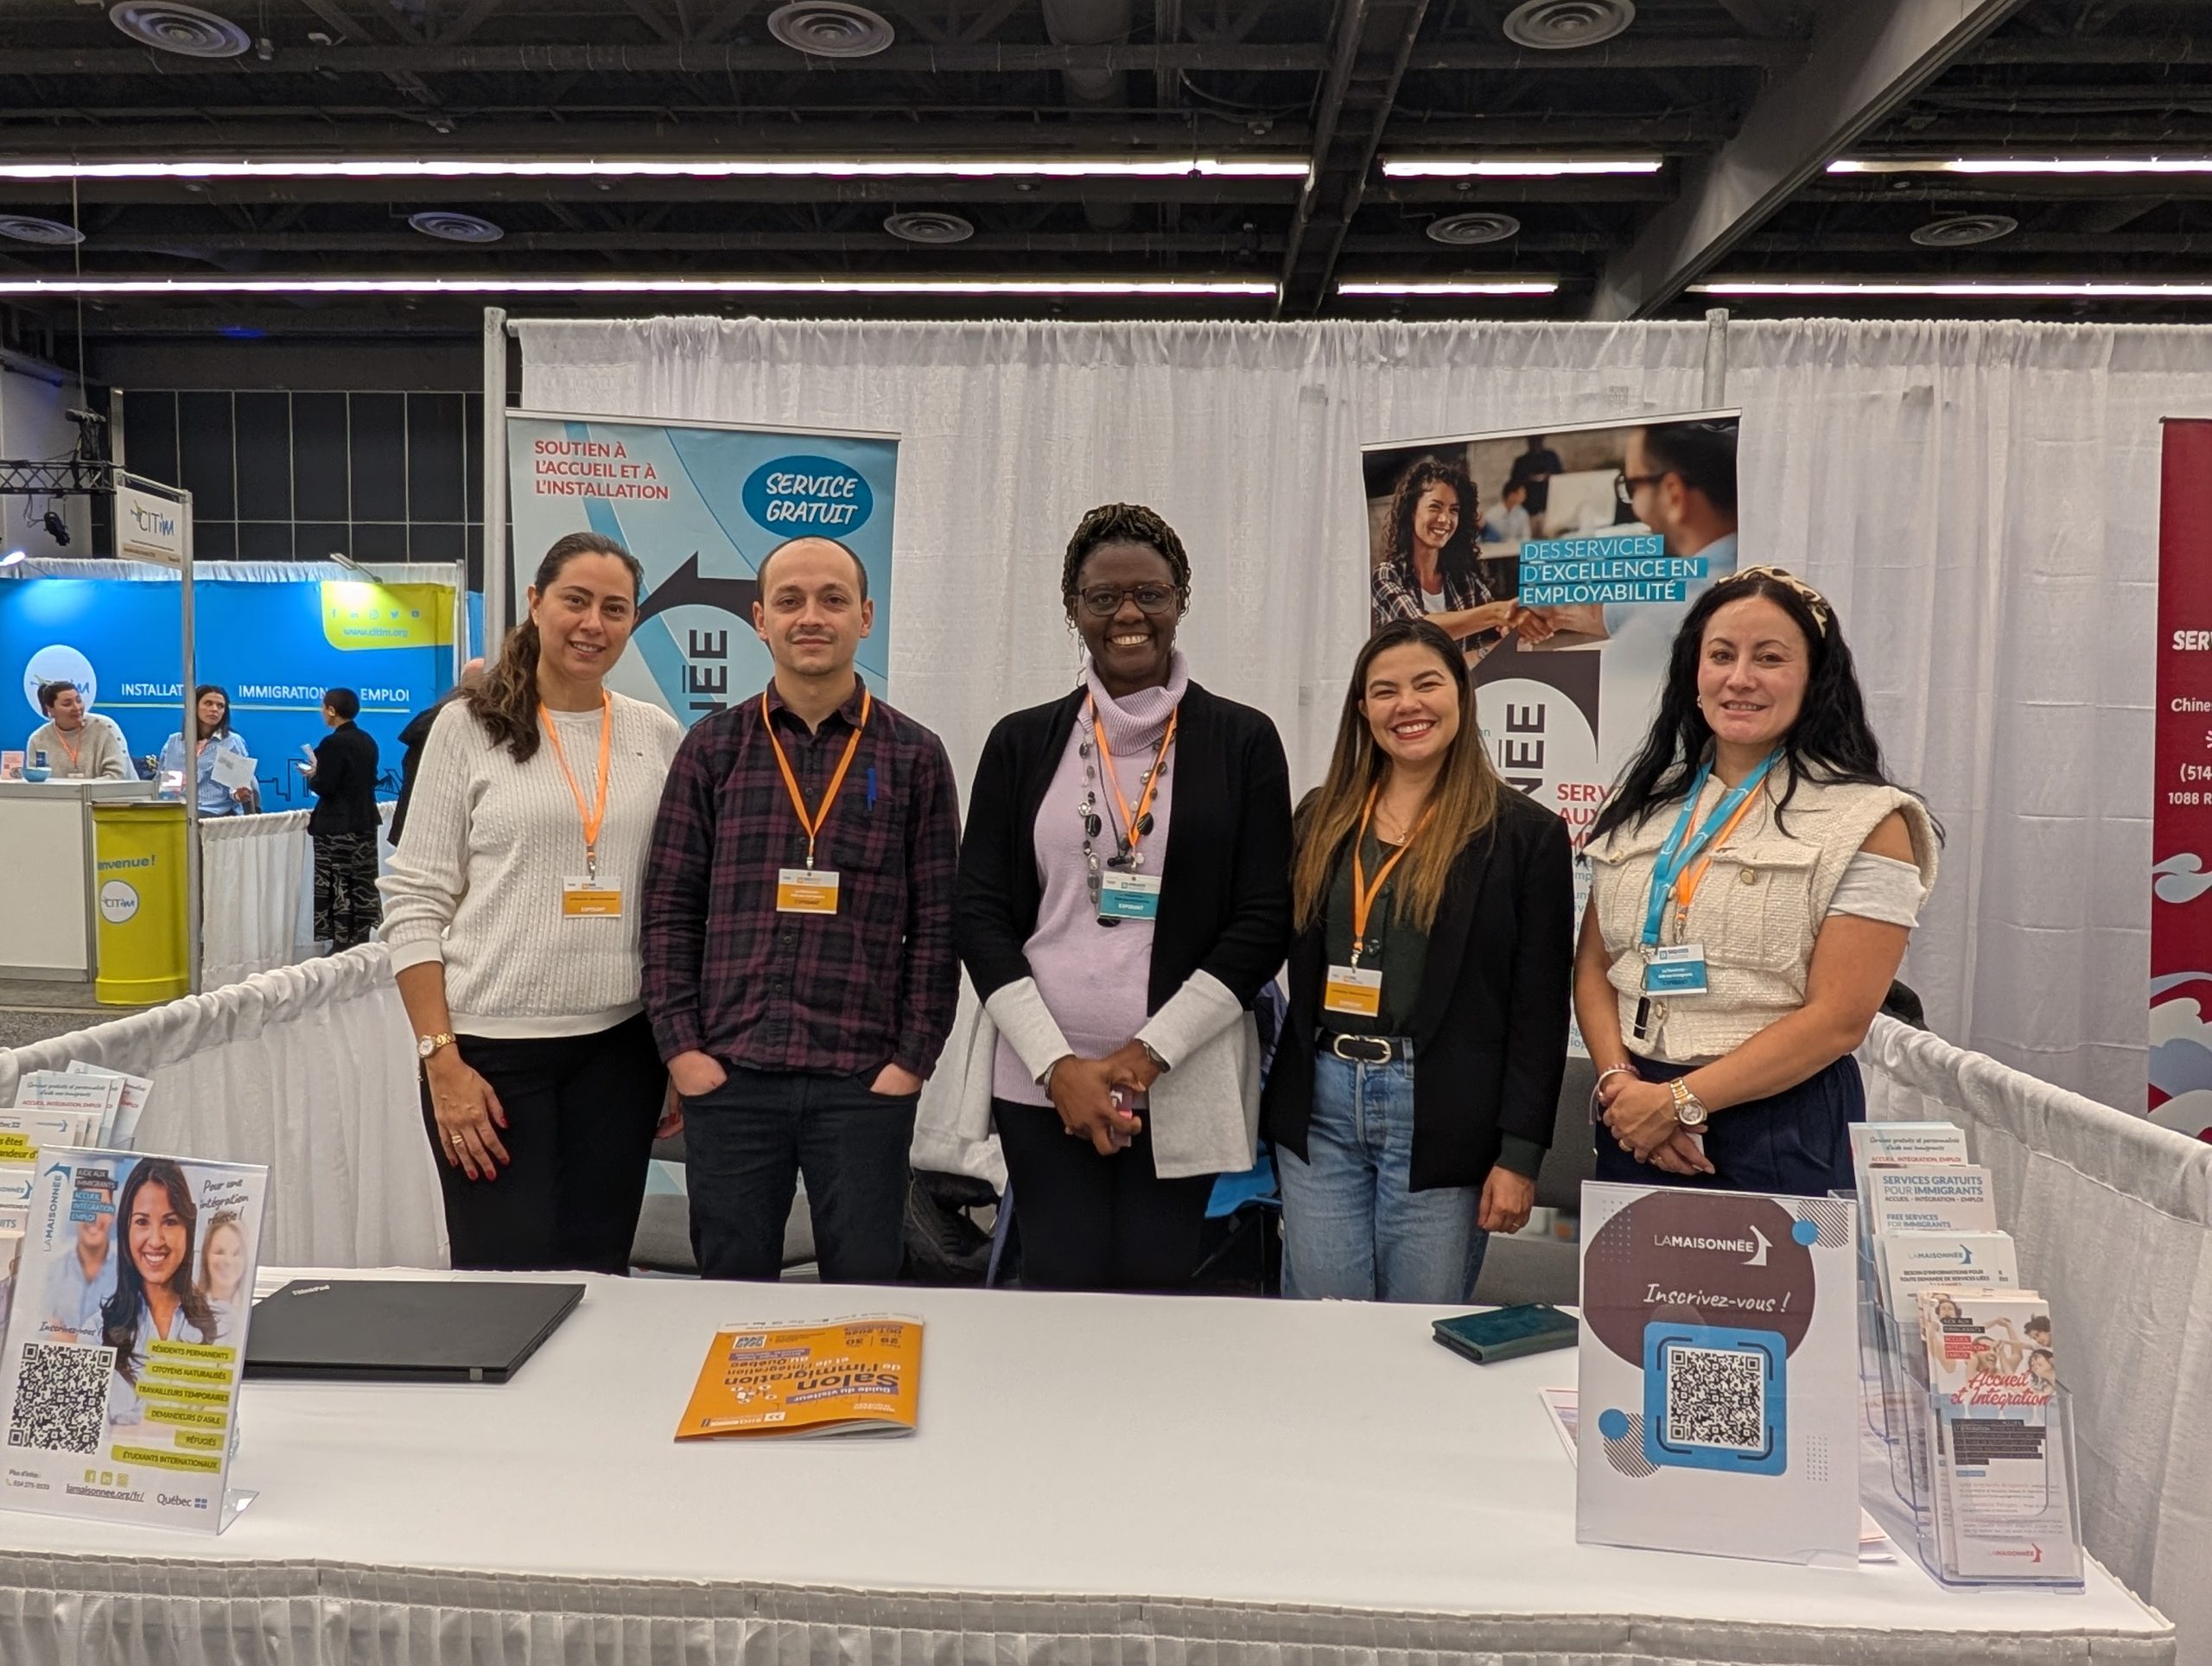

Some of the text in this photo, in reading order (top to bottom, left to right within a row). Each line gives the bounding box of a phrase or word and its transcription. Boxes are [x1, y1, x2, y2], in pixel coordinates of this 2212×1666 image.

[535, 440, 627, 459] SOUTIEN À
[535, 461, 657, 480] L'ACCUEIL ET À
[535, 480, 669, 499] L'INSTALLATION
[766, 473, 858, 499] SERVICE
[766, 500, 858, 525] GRATUIT
[1524, 537, 1656, 561] DES SERVICES
[1523, 560, 1698, 582] D'EXCELLENCE EN
[1522, 580, 1675, 604] EMPLOYABILITÉ
[2172, 630, 2212, 651] SER
[122, 684, 184, 696] INSTALLAT
[360, 689, 410, 702] EMPLOI
[2171, 696, 2212, 712] Chine
[2180, 763, 2212, 783] (514
[2168, 792, 2200, 804] 1088
[4, 1136, 22, 1146] êtes
[1883, 1176, 1983, 1186] SERVICES GRATUITS
[1884, 1186, 1983, 1195] POUR IMMIGRANTS
[1643, 1283, 1777, 1313] Inscrivez-vous
[151, 1345, 229, 1360] RÉSIDENTS PERMANENTS
[152, 1364, 226, 1380] CITOYENS NATURALISÉS
[724, 1363, 901, 1385] de l'immigration
[797, 1372, 899, 1390] Salon
[1968, 1368, 2032, 1389] Accueil
[138, 1385, 229, 1402] TRAVAILLEURS TEMPORAIRES
[793, 1390, 838, 1402] visiteur
[1950, 1386, 2050, 1410] et Intégration
[151, 1409, 196, 1421] DEMANDEURS
[186, 1434, 216, 1447] RÉFUGIÉS
[123, 1451, 218, 1469] ÉTUDIANTS INTERNATIONAUX
[156, 1493, 193, 1507] Québec
